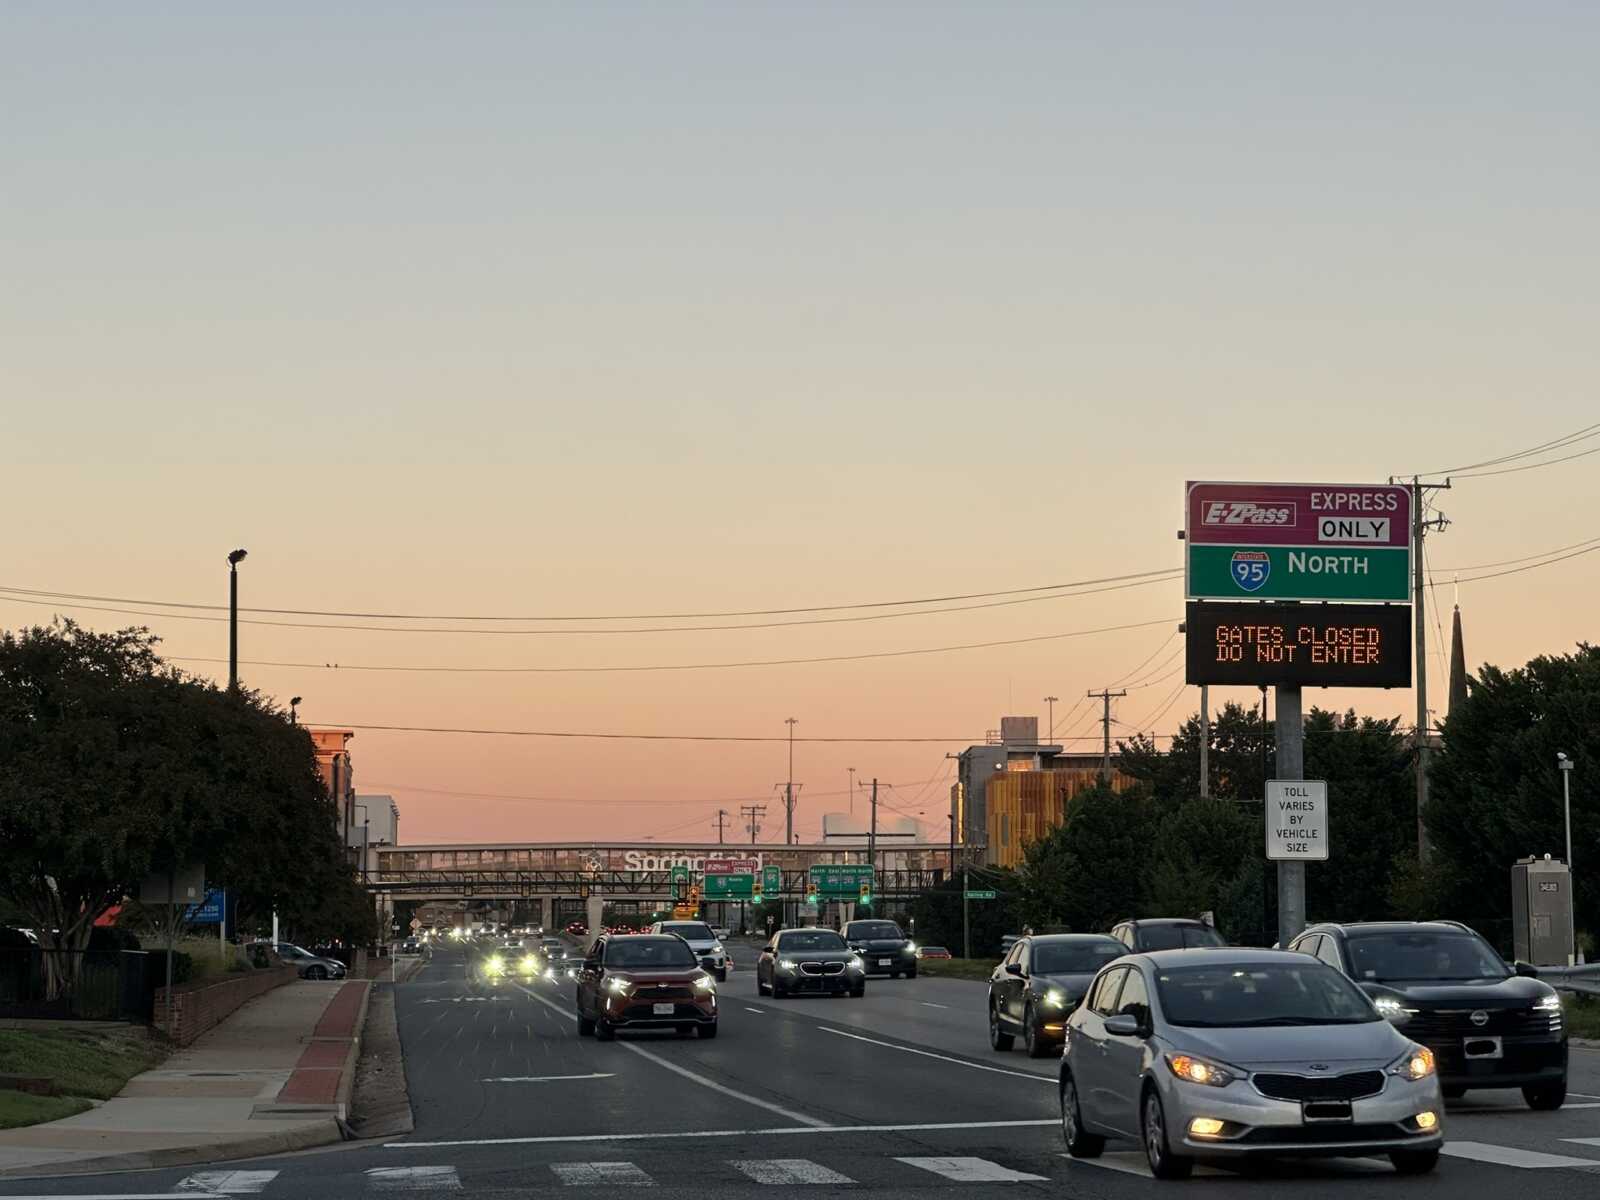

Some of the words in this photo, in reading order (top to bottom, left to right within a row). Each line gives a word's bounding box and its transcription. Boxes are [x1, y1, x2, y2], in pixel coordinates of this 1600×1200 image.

[1310, 492, 1398, 512] EXPRESS
[1321, 520, 1385, 538] ONLY
[1237, 563, 1264, 581] 95
[1216, 625, 1284, 643] GATES
[1298, 627, 1380, 645] CLOSED
[1216, 644, 1243, 661] DO
[1257, 645, 1297, 662] NOT
[1312, 645, 1380, 664] ENTER
[1284, 787, 1309, 797] TOLL
[1279, 801, 1315, 811] VARIES
[1290, 815, 1304, 825] BY
[1276, 828, 1319, 839] VEHICLE
[1286, 842, 1309, 853] SIZE
[624, 850, 763, 878] Springd
